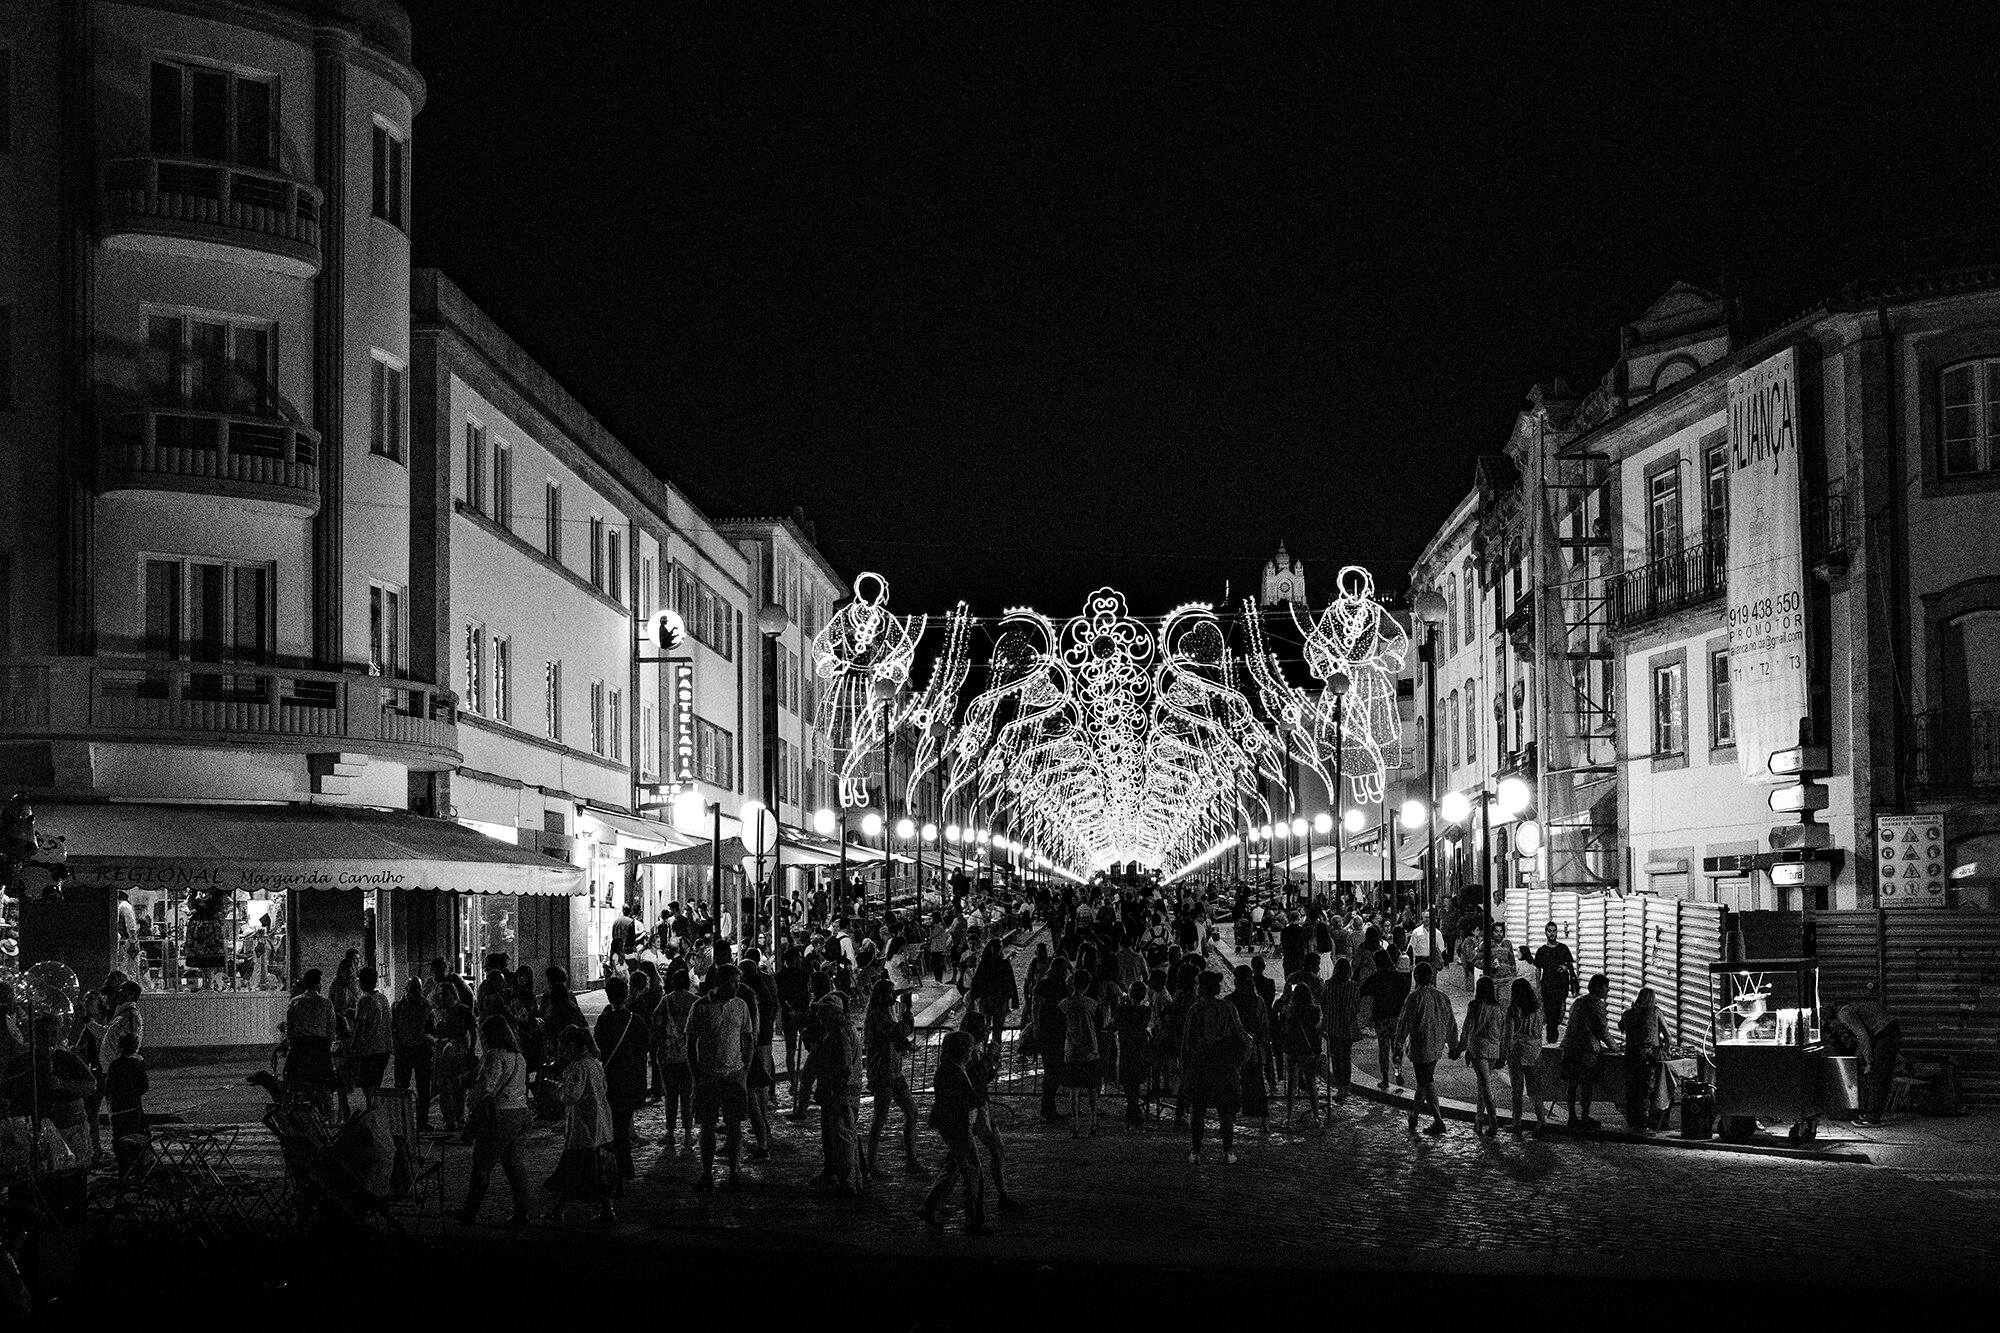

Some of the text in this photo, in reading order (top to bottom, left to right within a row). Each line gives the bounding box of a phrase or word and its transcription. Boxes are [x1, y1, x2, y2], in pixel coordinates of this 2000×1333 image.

[1731, 378, 1795, 475] ALIANÇA
[1730, 591, 1800, 627] 919 438 550
[1729, 614, 1802, 642] PROMOTOR
[1733, 655, 1801, 682] T1 T2 T3
[678, 667, 693, 778] PASTELARIA
[95, 865, 224, 884] REGIONAL
[240, 870, 332, 888] Margarida
[338, 870, 405, 885] Carvalho
